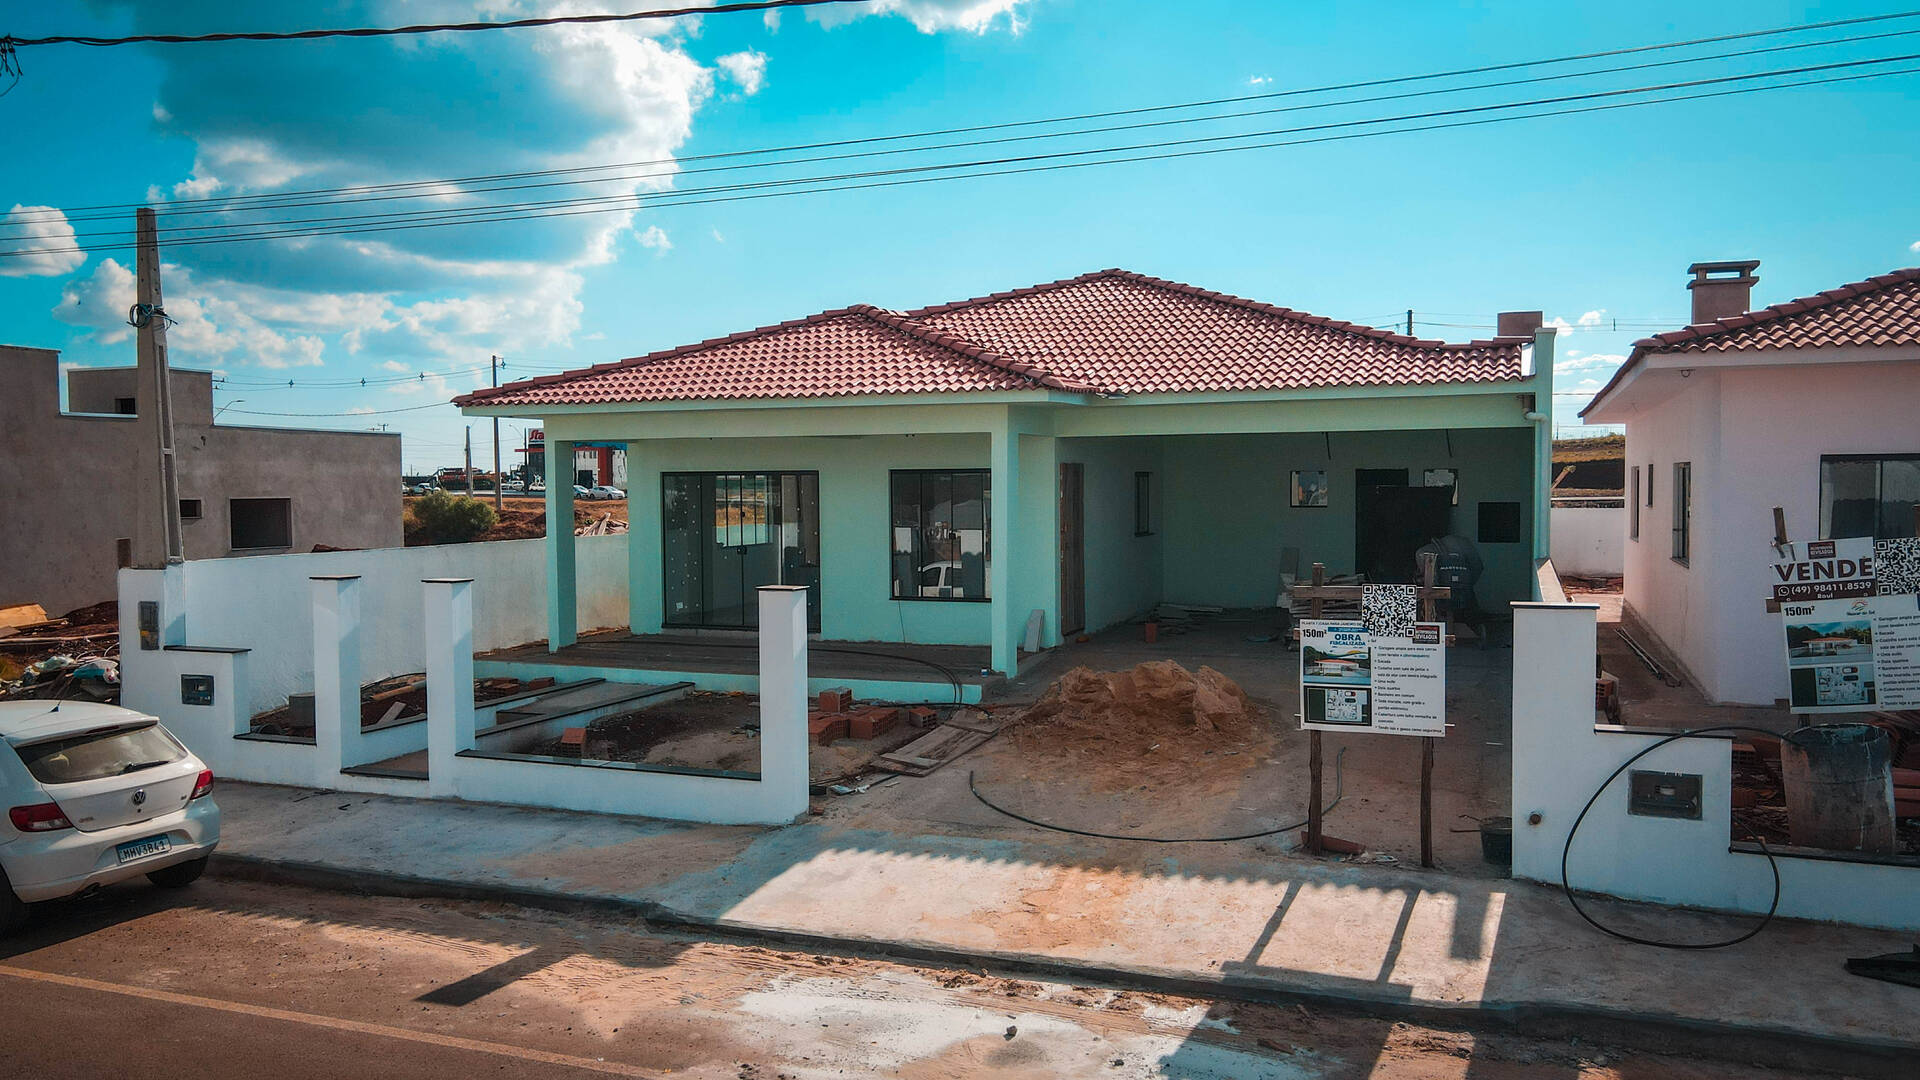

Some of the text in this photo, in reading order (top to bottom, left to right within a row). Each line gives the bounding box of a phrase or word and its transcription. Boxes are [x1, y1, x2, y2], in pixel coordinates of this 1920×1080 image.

[1774, 558, 1873, 582] VENDE
[1791, 582, 1871, 595] (49) 98411.8539
[1784, 605, 1815, 617] 150m²
[1303, 629, 1327, 638] 150m²
